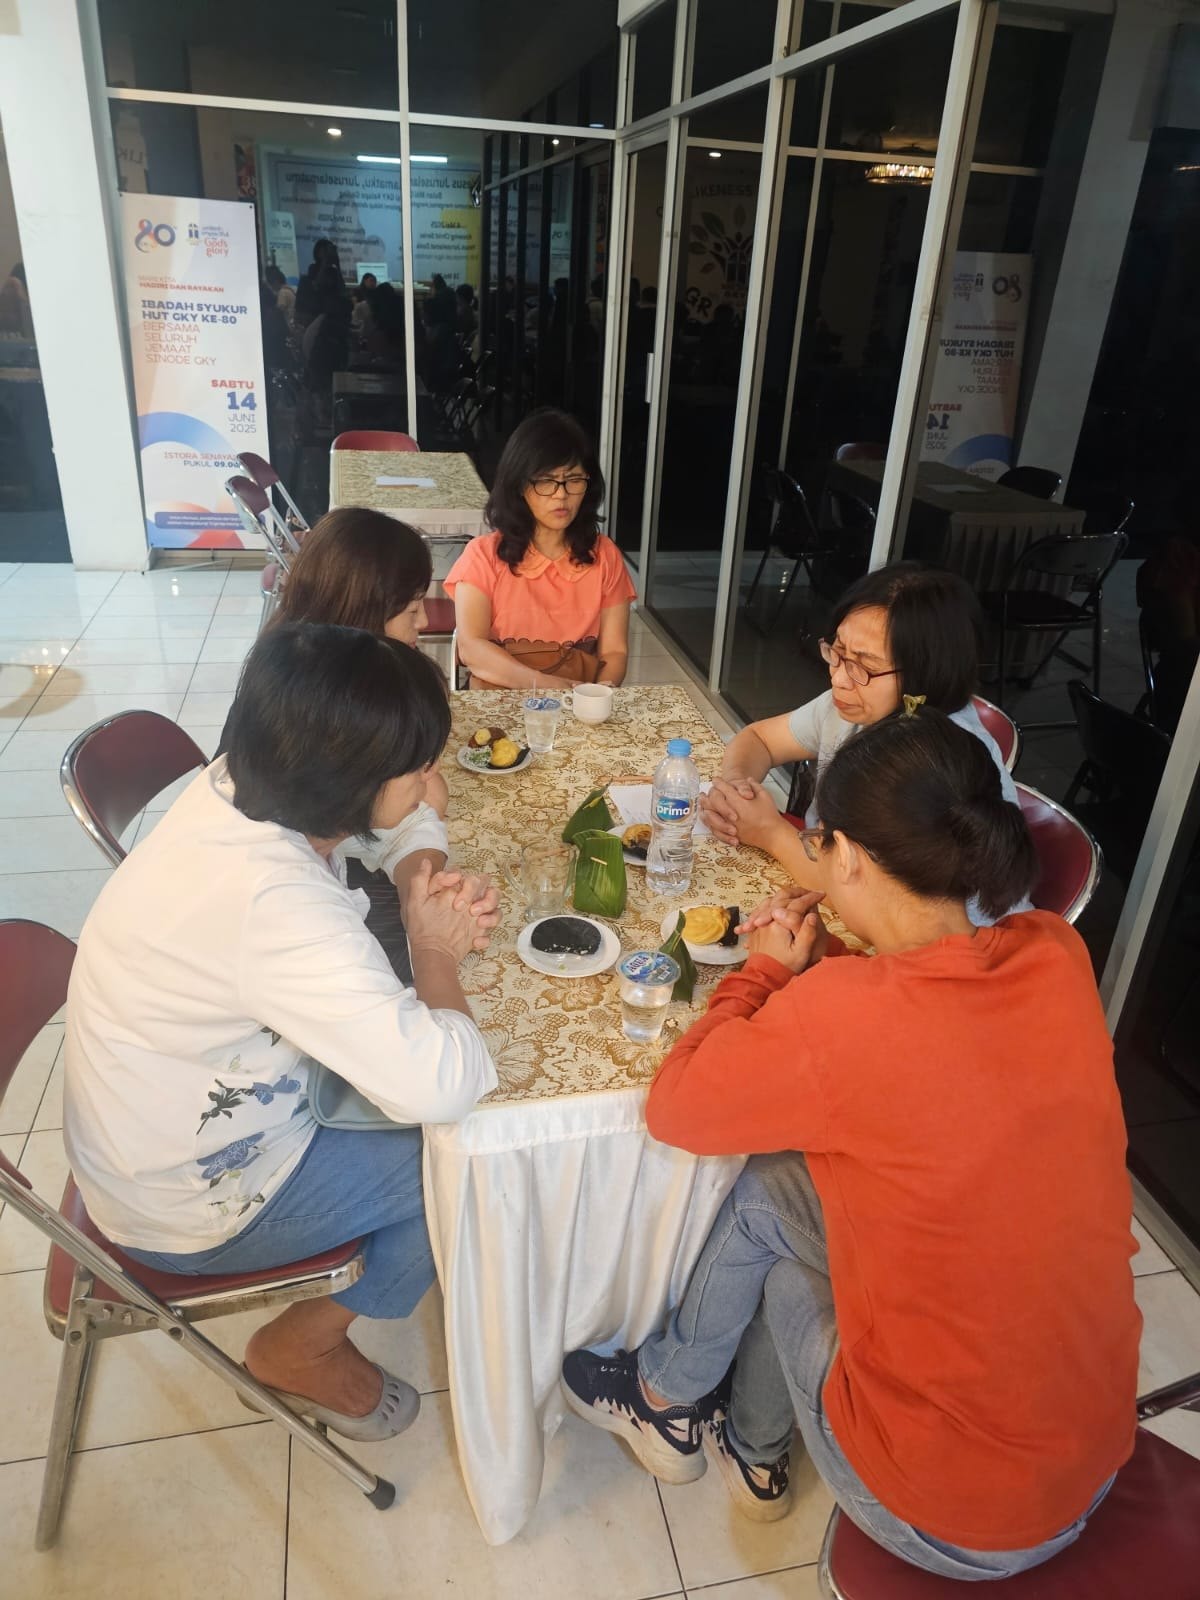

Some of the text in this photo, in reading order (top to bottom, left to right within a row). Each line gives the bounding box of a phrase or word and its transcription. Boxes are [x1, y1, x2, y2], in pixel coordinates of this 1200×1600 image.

[141, 299, 248, 315] IBADAH SYUKUR
[142, 310, 237, 325] HUT GKY KE-80
[143, 321, 201, 333] BERSAMA
[144, 332, 197, 344] SELURUH
[145, 343, 192, 354] JEMAAT
[145, 353, 217, 367] SINODE GKY
[211, 379, 255, 390] SABTU
[227, 391, 258, 412] 14
[228, 412, 257, 424] JUNI
[229, 423, 257, 434] 2025
[164, 451, 240, 462] ISTORA SENAYA
[183, 459, 212, 468] PUKUL
